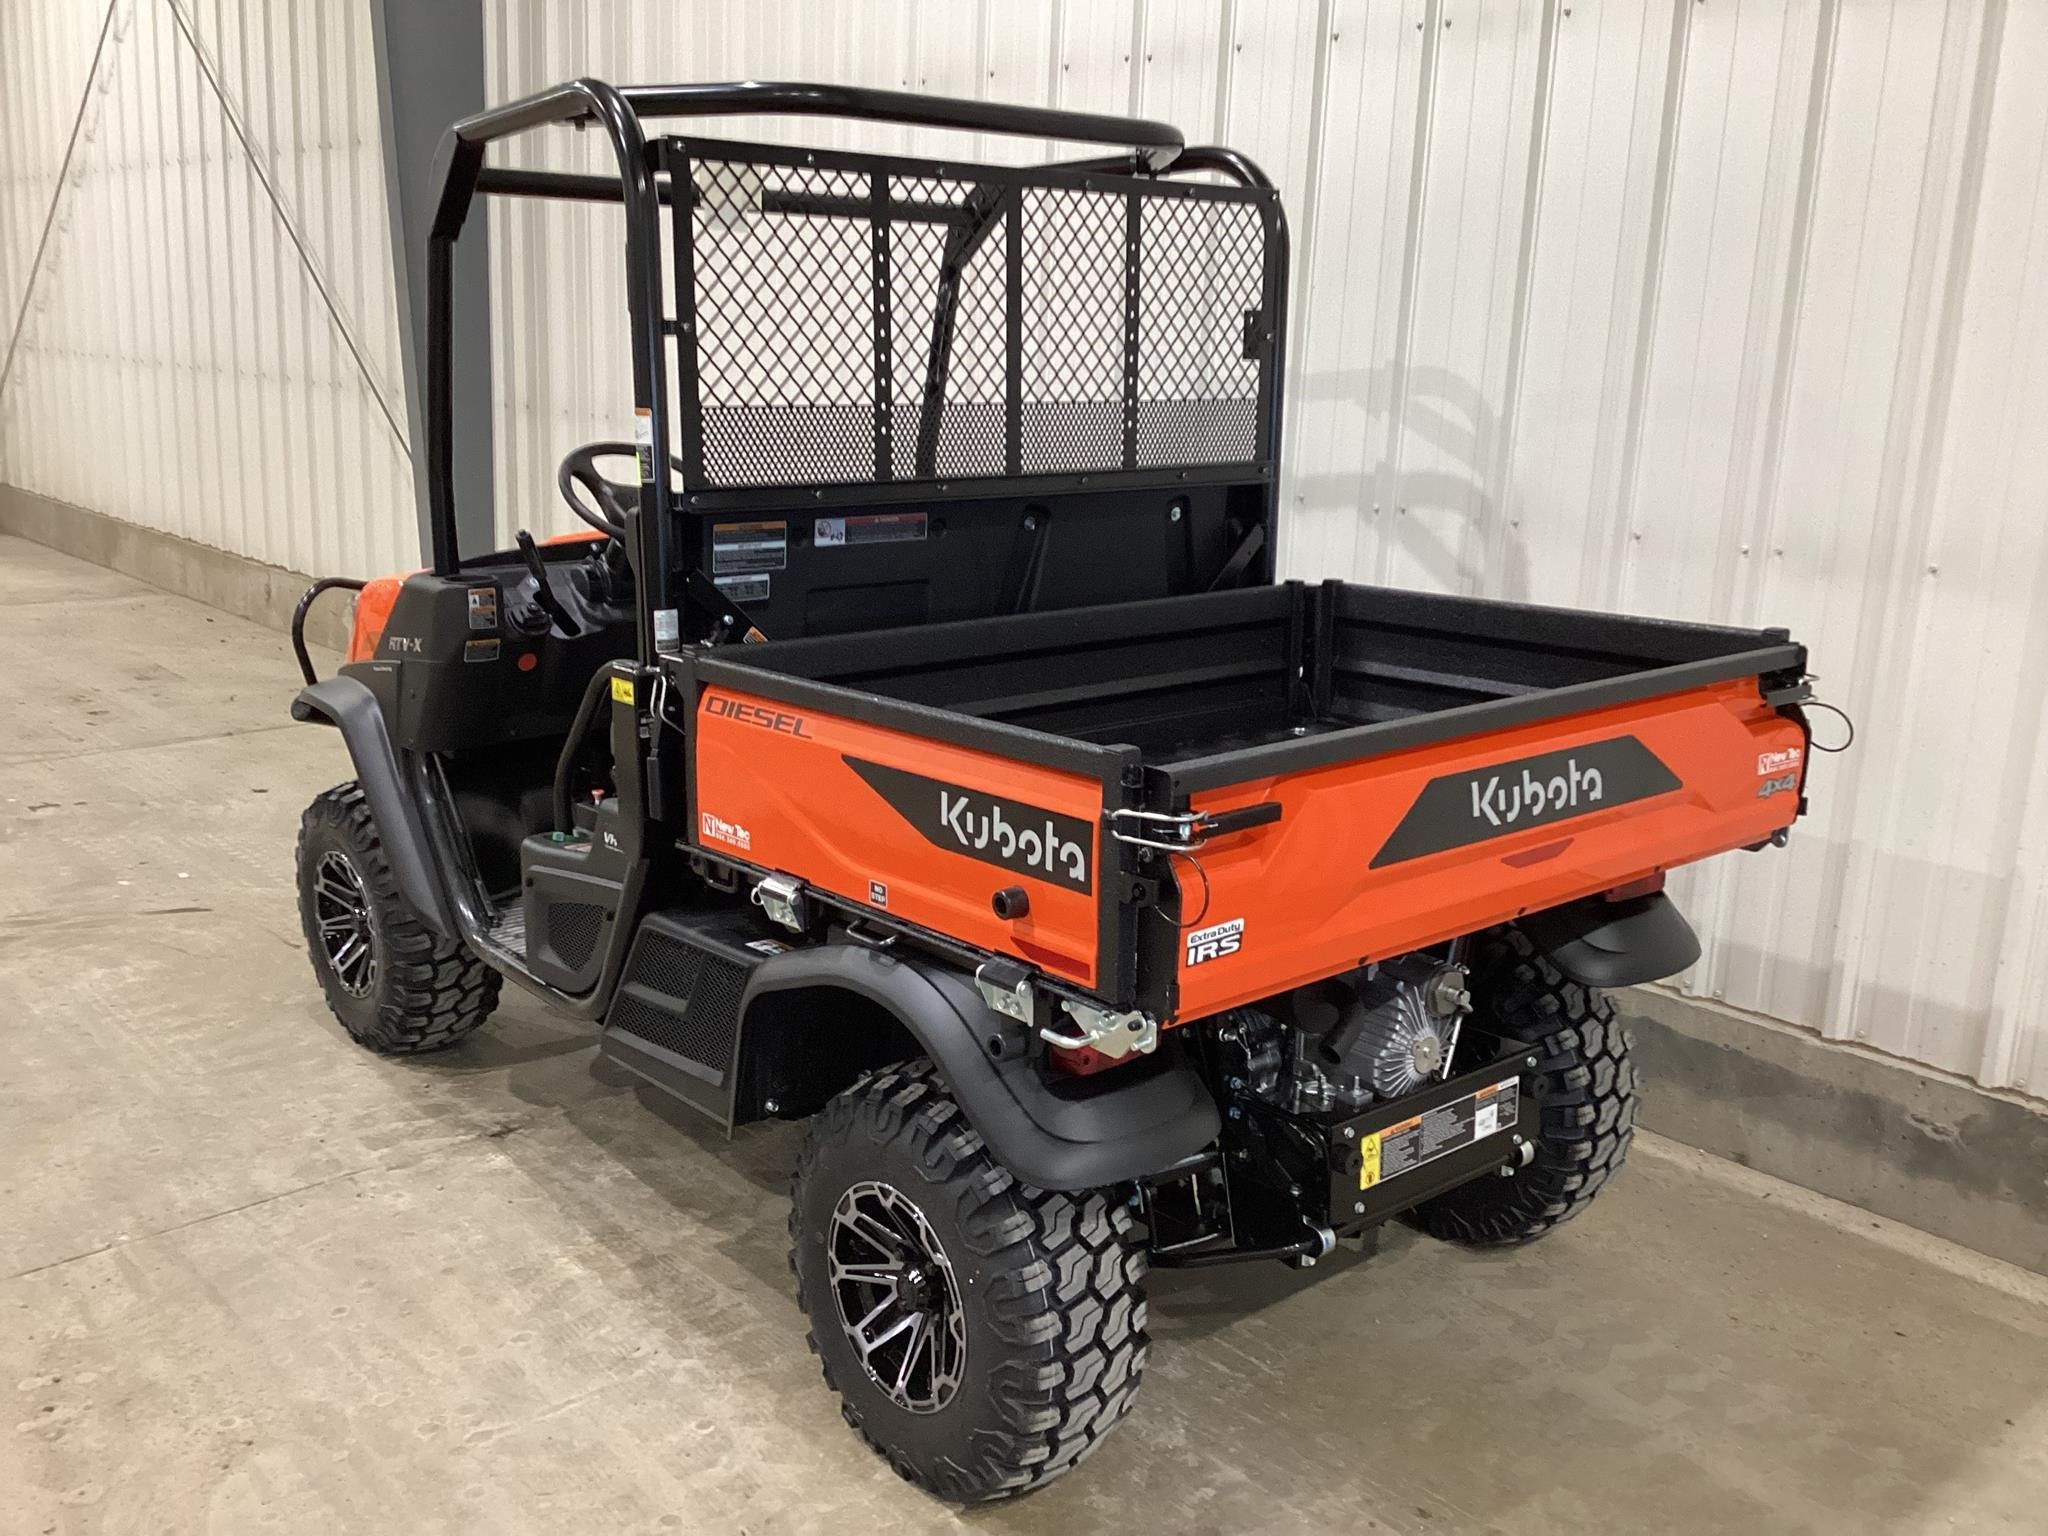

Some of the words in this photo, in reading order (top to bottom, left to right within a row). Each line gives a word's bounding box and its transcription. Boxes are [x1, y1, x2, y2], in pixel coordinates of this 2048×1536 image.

[703, 695, 813, 740] DIESEL
[1471, 758, 1603, 826] Kubota
[940, 790, 1085, 882] Kubota
[1187, 934, 1241, 967] IRS
[1190, 931, 1217, 944] Extra
[1217, 923, 1241, 936] Duty
